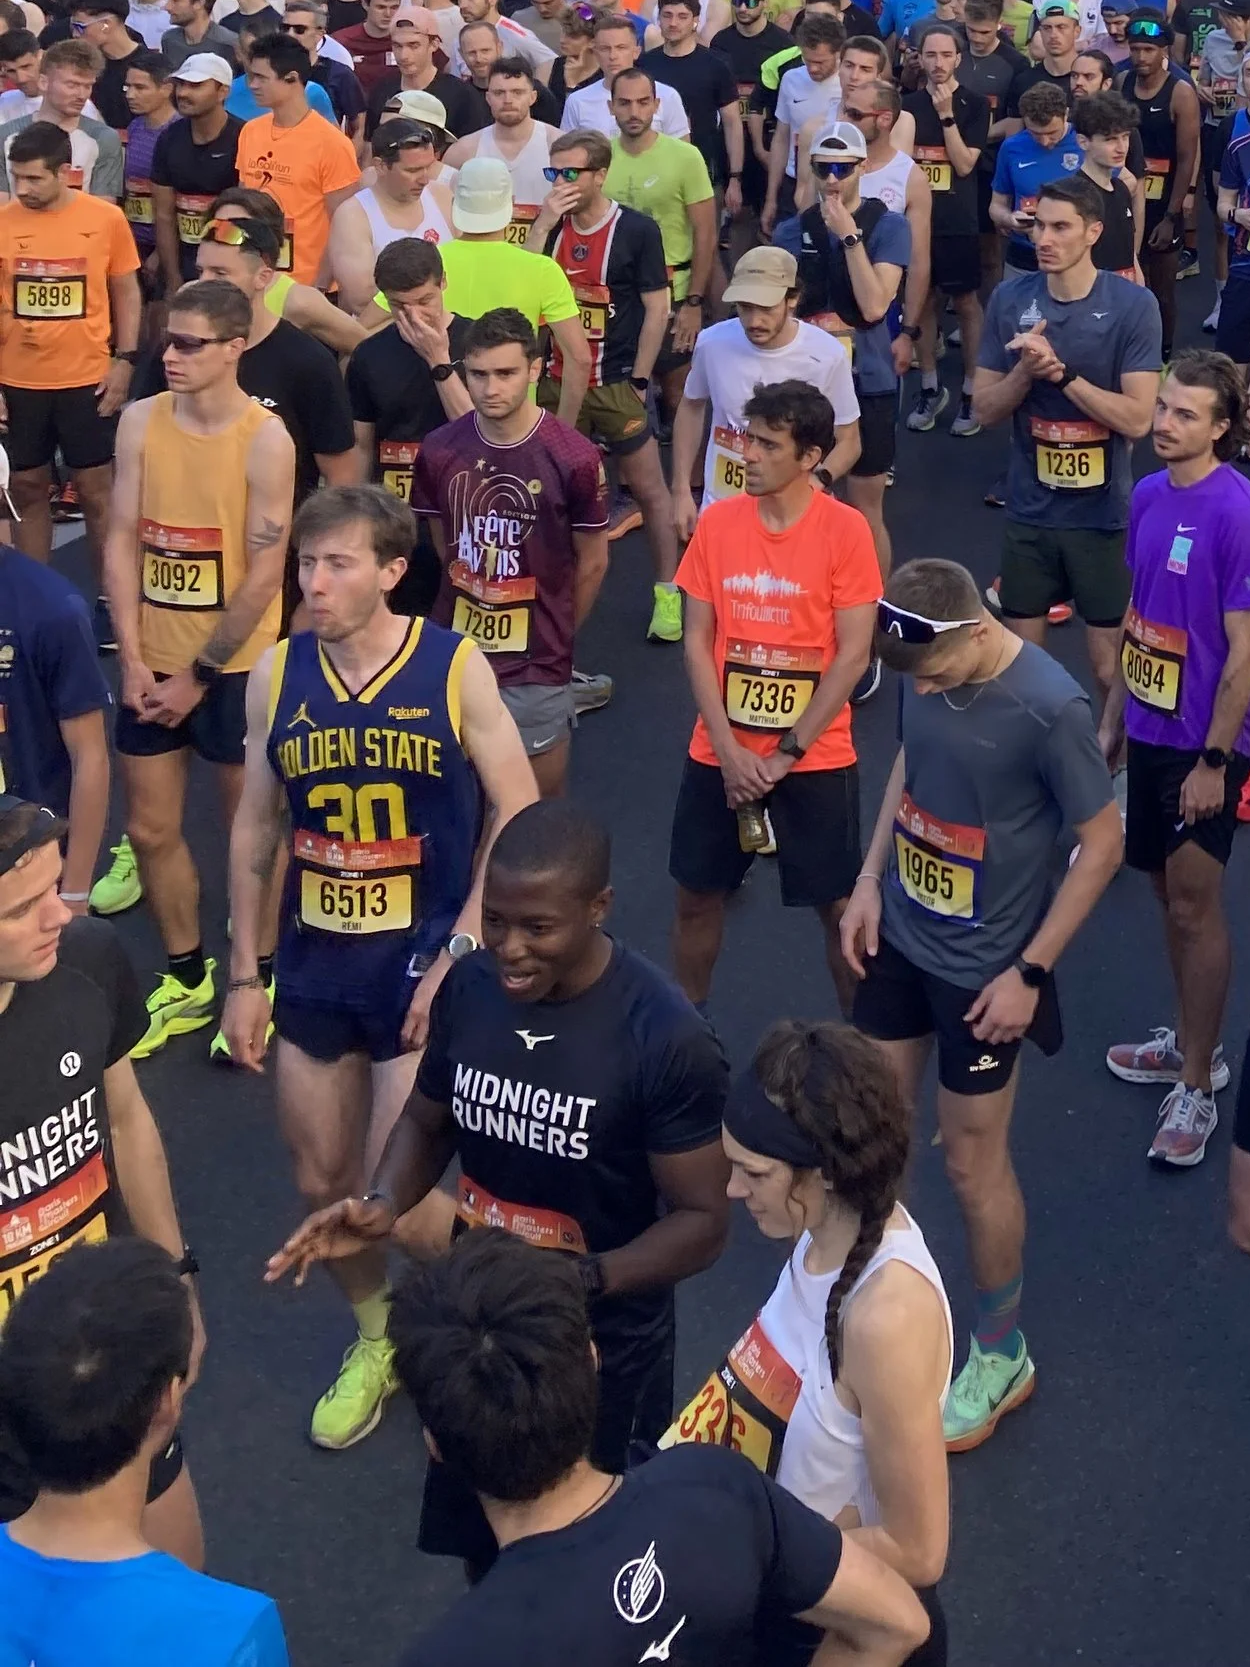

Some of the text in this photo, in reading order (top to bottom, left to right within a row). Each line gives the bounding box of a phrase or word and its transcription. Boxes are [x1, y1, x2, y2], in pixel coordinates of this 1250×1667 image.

[28, 285, 71, 307] 5898
[1046, 451, 1090, 477] 1236
[151, 559, 200, 592] 3092
[464, 605, 512, 641] 7280
[1127, 649, 1165, 694] 8094
[388, 706, 429, 717] Rakuten
[740, 679, 796, 714] 7336
[364, 728, 442, 778] STATE
[307, 783, 407, 843] 30
[904, 847, 953, 900] 1965
[320, 880, 388, 918] 6513
[454, 1063, 597, 1129] MIDNIGHT
[0, 1087, 97, 1171] NIGHT
[452, 1096, 589, 1160] RUNNERS
[29, 1237, 55, 1256] ZONE
